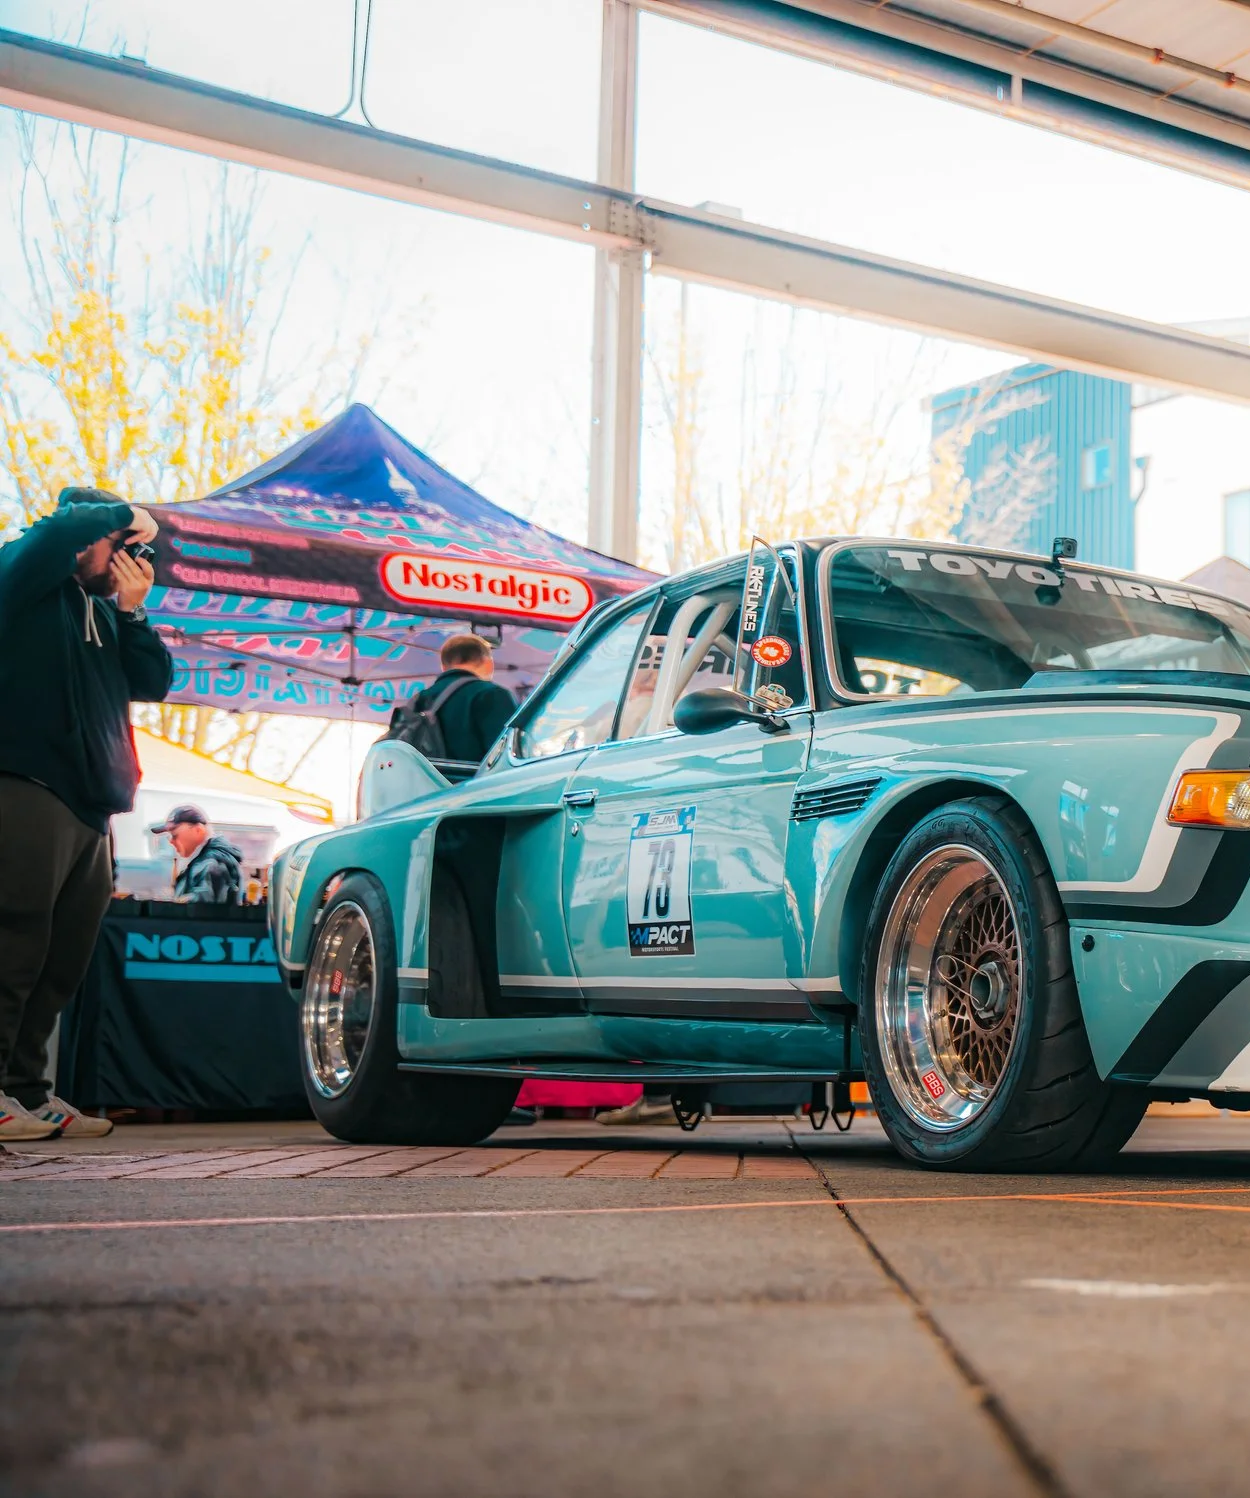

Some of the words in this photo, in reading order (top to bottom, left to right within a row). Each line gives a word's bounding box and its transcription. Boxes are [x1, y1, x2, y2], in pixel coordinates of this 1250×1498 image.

[402, 561, 572, 610] Nostalgic
[888, 550, 1064, 587] TOYO
[1064, 573, 1231, 617] TIRES
[642, 839, 677, 919] 73
[924, 1072, 944, 1097] BBS
